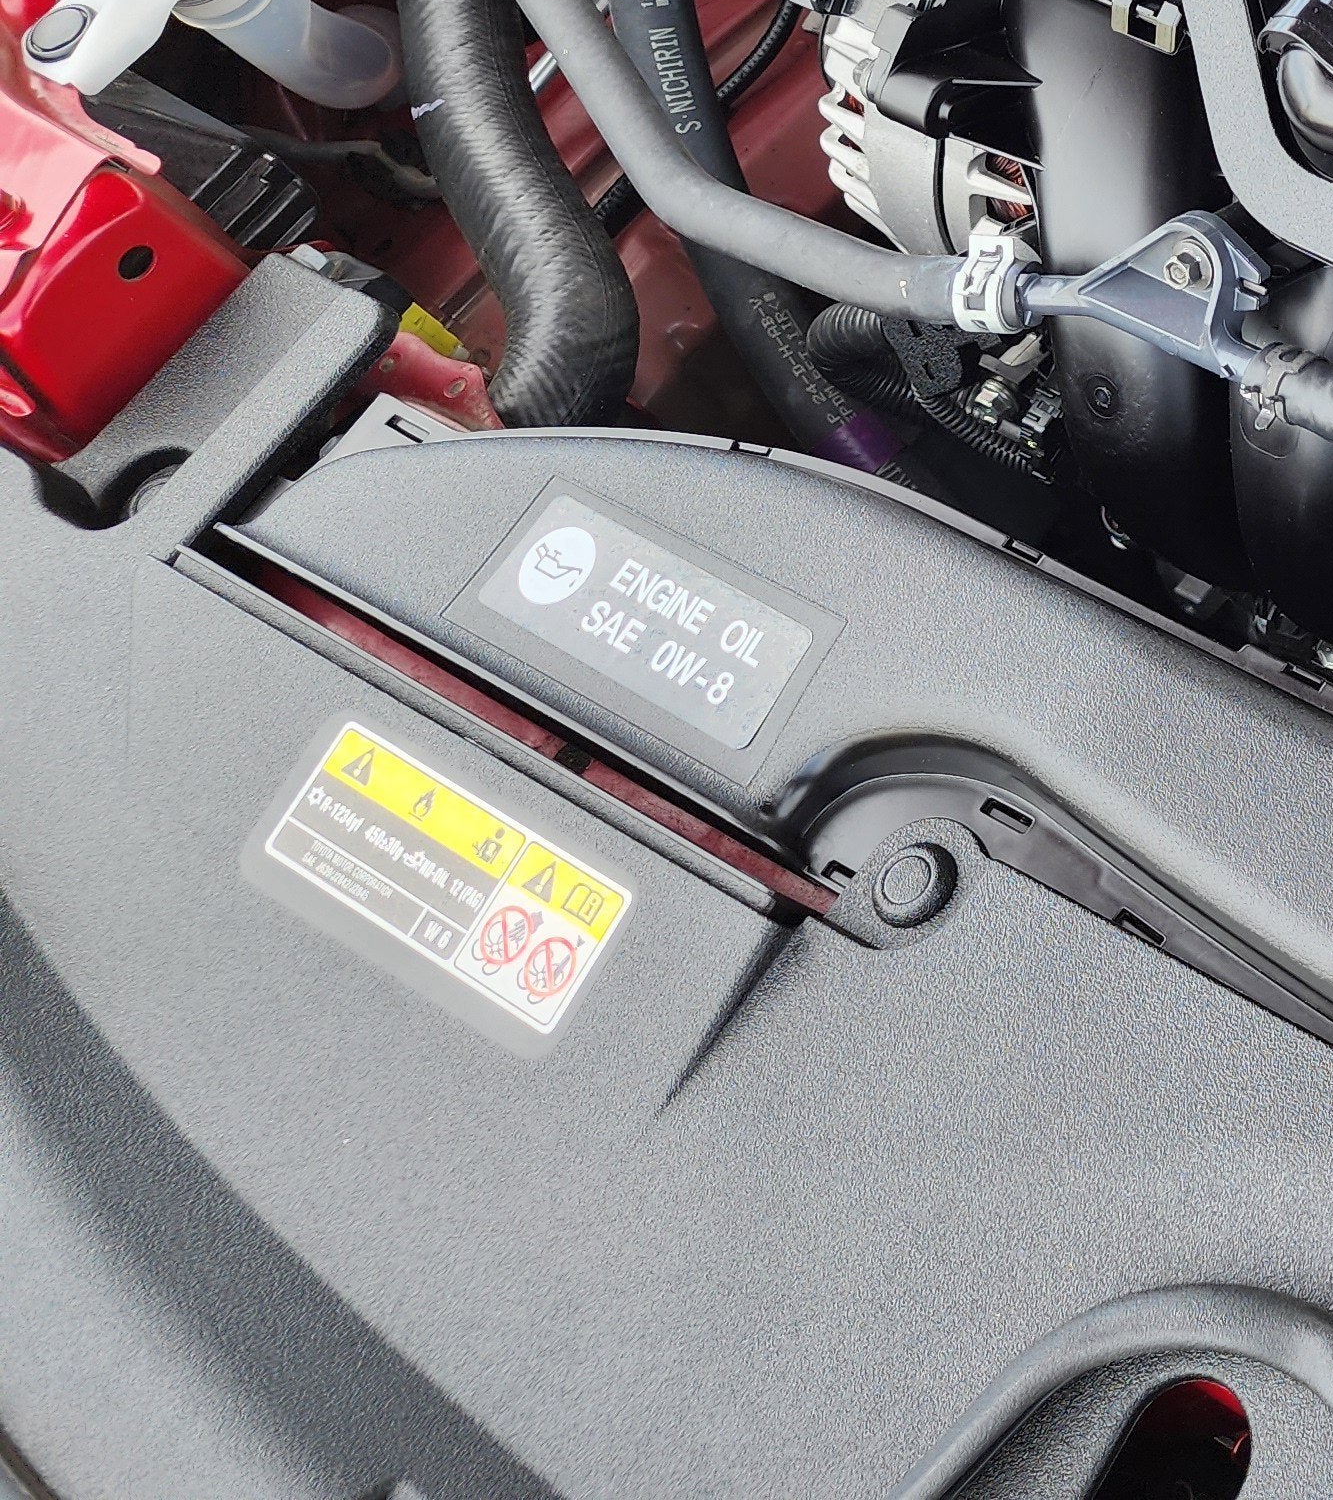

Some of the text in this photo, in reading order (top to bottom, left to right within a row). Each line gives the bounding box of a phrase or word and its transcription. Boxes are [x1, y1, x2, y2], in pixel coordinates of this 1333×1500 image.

[577, 595, 738, 708] SAE 0W-8
[607, 556, 774, 669] ENGINE OIL
[309, 838, 394, 900] TOYOTA MOTOR CORPORATION
